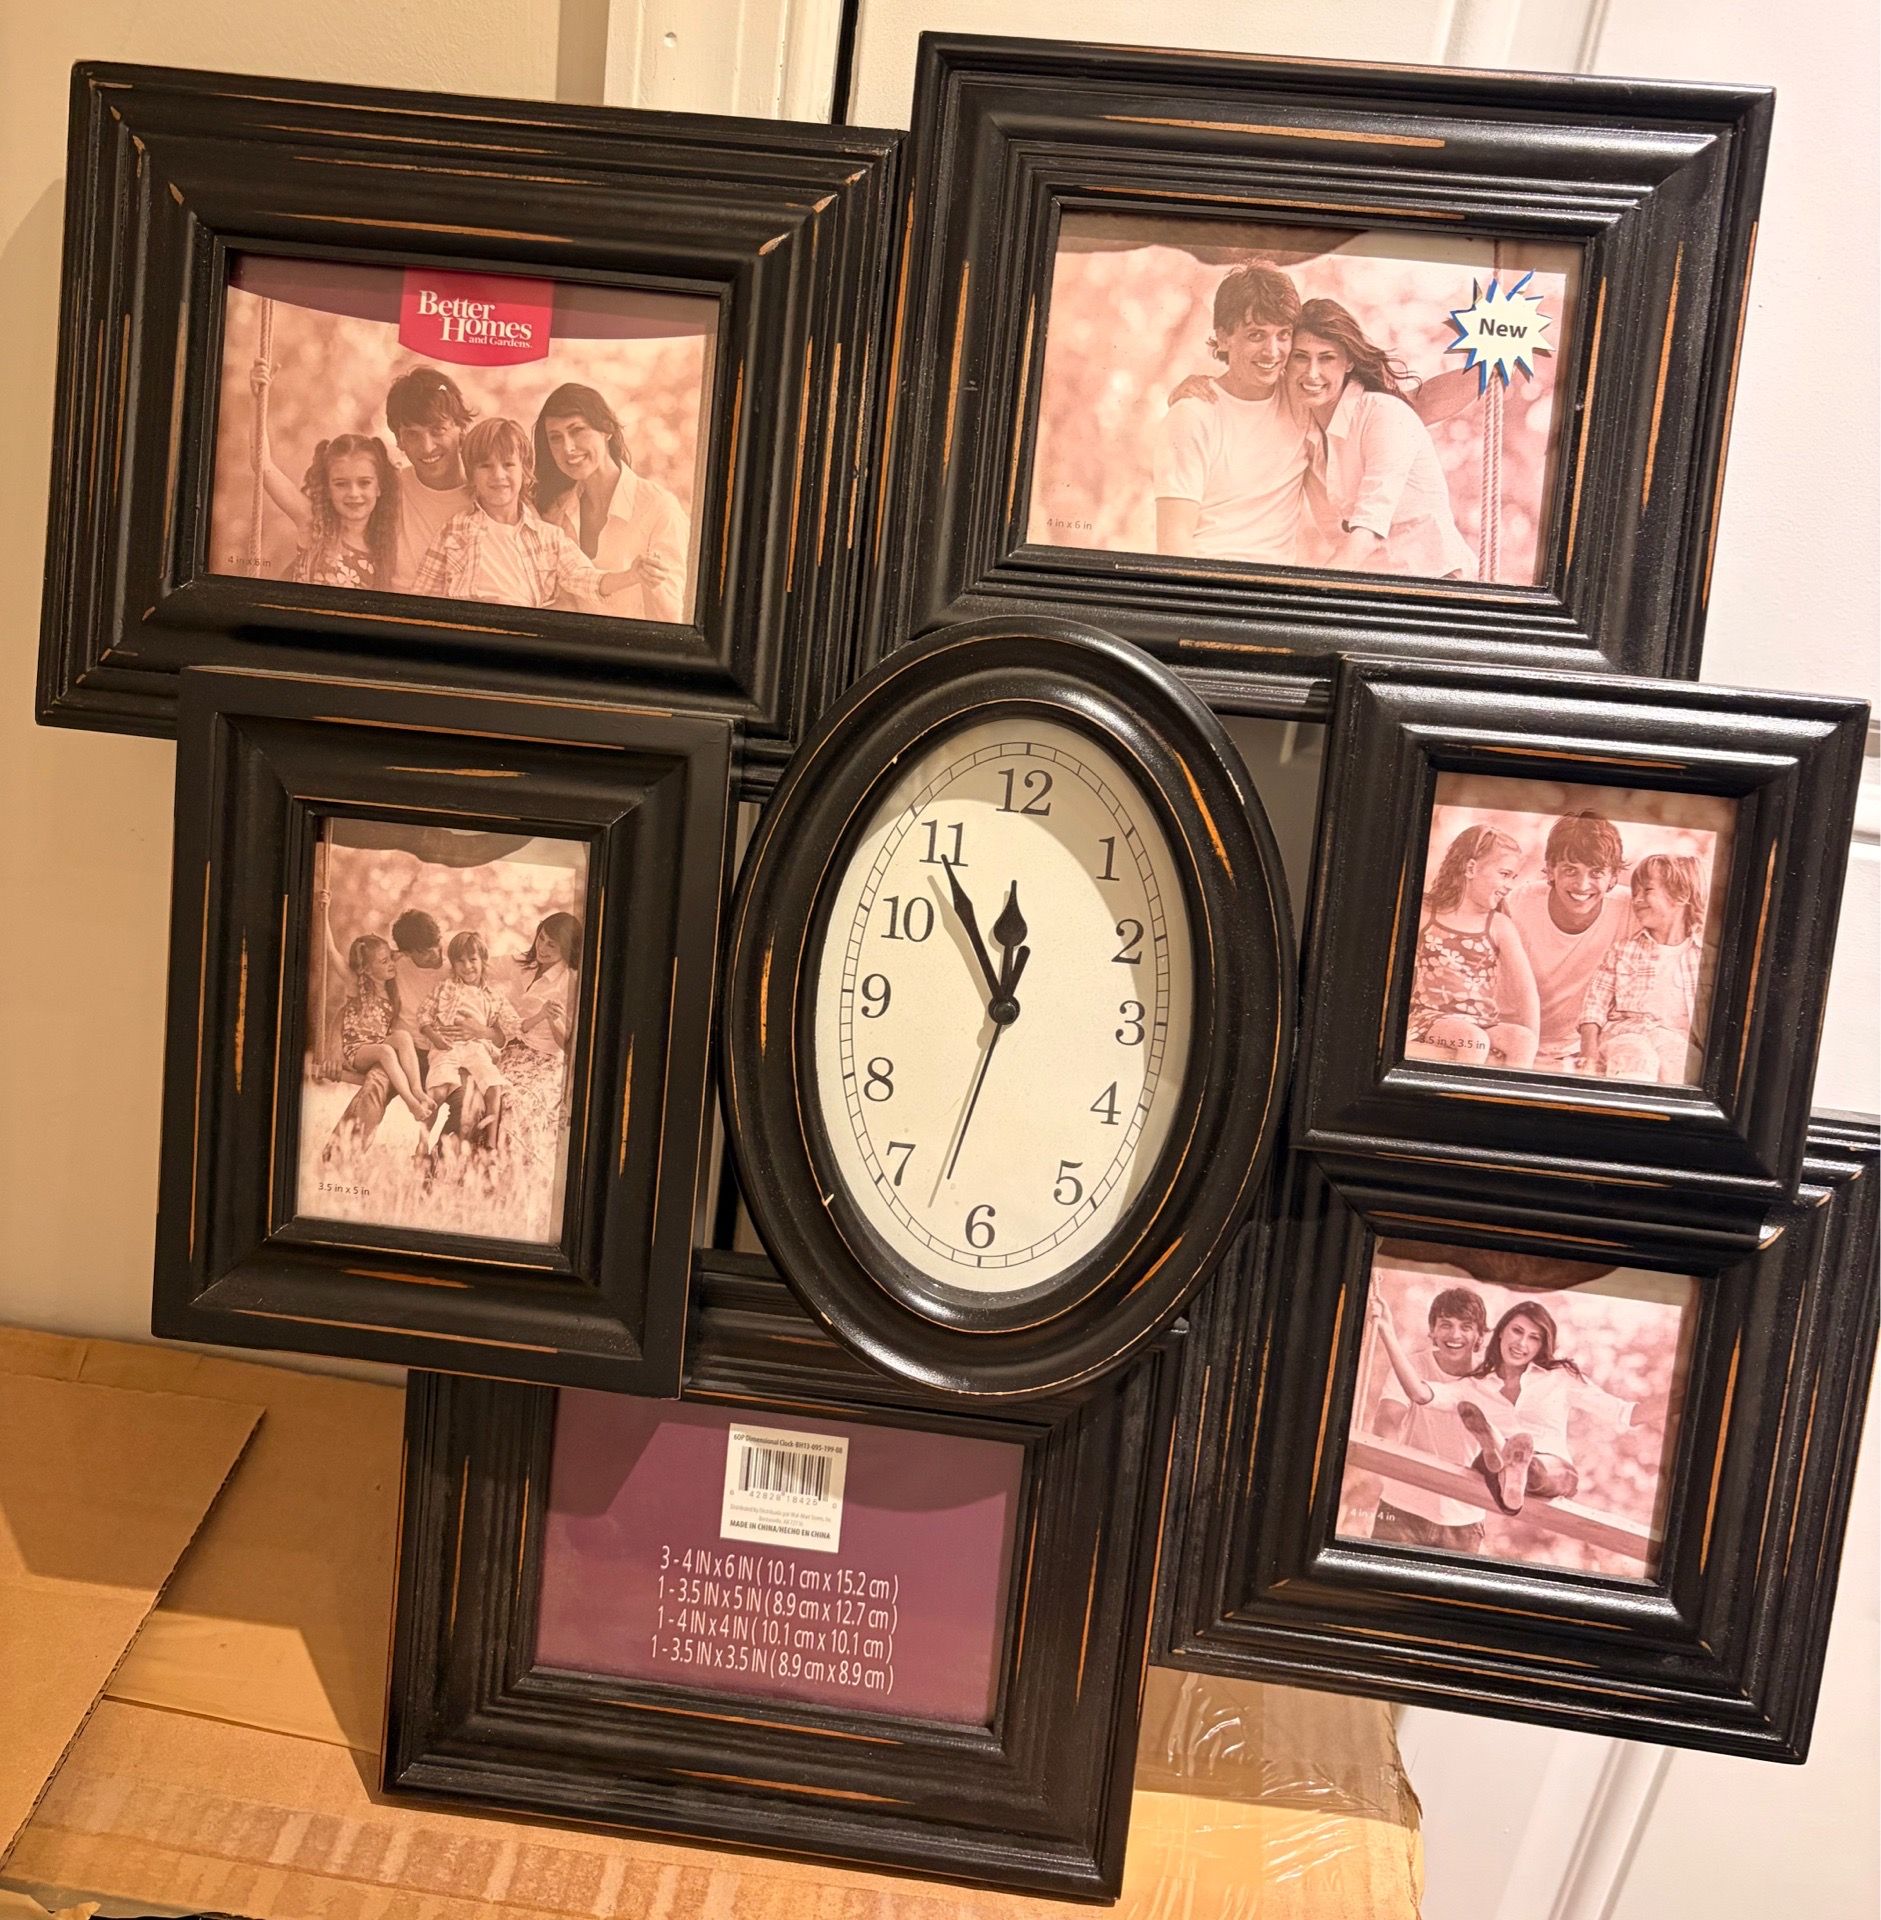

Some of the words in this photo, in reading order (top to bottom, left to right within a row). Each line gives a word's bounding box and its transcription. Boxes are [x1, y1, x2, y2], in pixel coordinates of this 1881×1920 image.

[416, 290, 496, 320] Better
[440, 317, 532, 343] Homes
[468, 335, 487, 345] and
[1479, 318, 1528, 339] New
[1047, 518, 1052, 526] 4
[1055, 518, 1064, 527] in
[1075, 520, 1080, 529] 6
[1083, 521, 1092, 530] in
[995, 768, 1054, 817] 12
[919, 819, 969, 868] 11
[1096, 836, 1121, 882] 1
[880, 896, 935, 943] 10
[1111, 918, 1144, 965] 2
[860, 973, 892, 1019] 9
[1115, 1000, 1146, 1046] 3
[1437, 1036, 1446, 1046] in
[1457, 1039, 1473, 1049] 3.5
[1476, 1040, 1485, 1049] in
[863, 1056, 895, 1102] 8
[1090, 1081, 1121, 1126] 4
[886, 1141, 916, 1186] 7
[1053, 1159, 1083, 1206] 5
[319, 1182, 332, 1192] 3.5
[334, 1184, 343, 1192] in
[353, 1186, 359, 1194] 5
[361, 1186, 370, 1196] in
[964, 1204, 997, 1249] 6
[730, 1519, 748, 1529] MADE
[749, 1522, 757, 1530] IN
[801, 1529, 810, 1537] EN
[811, 1530, 831, 1540] CHINA
[1377, 1511, 1383, 1520] 4
[1386, 1512, 1395, 1521] in
[661, 1546, 670, 1570] 3
[682, 1549, 692, 1573] 4
[696, 1550, 710, 1575] IN
[714, 1559, 722, 1577] x
[726, 1554, 735, 1579] 6
[738, 1555, 754, 1580] IN
[800, 1570, 820, 1590] cm
[823, 1573, 832, 1592] x
[837, 1569, 866, 1597] 15.2
[659, 1576, 664, 1599] 1
[678, 1578, 701, 1604] 3.5
[704, 1581, 719, 1607] IN
[722, 1590, 731, 1608] x
[734, 1585, 743, 1610] 5
[746, 1587, 762, 1612] IN
[799, 1600, 819, 1621] cm
[822, 1603, 831, 1622] x
[837, 1600, 866, 1627] 12.7
[658, 1606, 664, 1629] 1
[677, 1609, 687, 1632] 4
[690, 1610, 705, 1634] IN
[708, 1618, 717, 1636] x
[720, 1614, 730, 1638] 4
[733, 1616, 748, 1641] IN
[794, 1630, 814, 1650] cm
[817, 1633, 826, 1651] x
[832, 1629, 859, 1656] 10.1
[651, 1635, 657, 1658] 1
[671, 1637, 693, 1663] 3.5
[696, 1641, 712, 1666] IN
[714, 1649, 723, 1668] x
[726, 1645, 749, 1671] 3.5
[752, 1648, 767, 1673] IN
[804, 1661, 824, 1682] cm
[827, 1664, 836, 1683] x
[839, 1660, 862, 1687] 8.9
